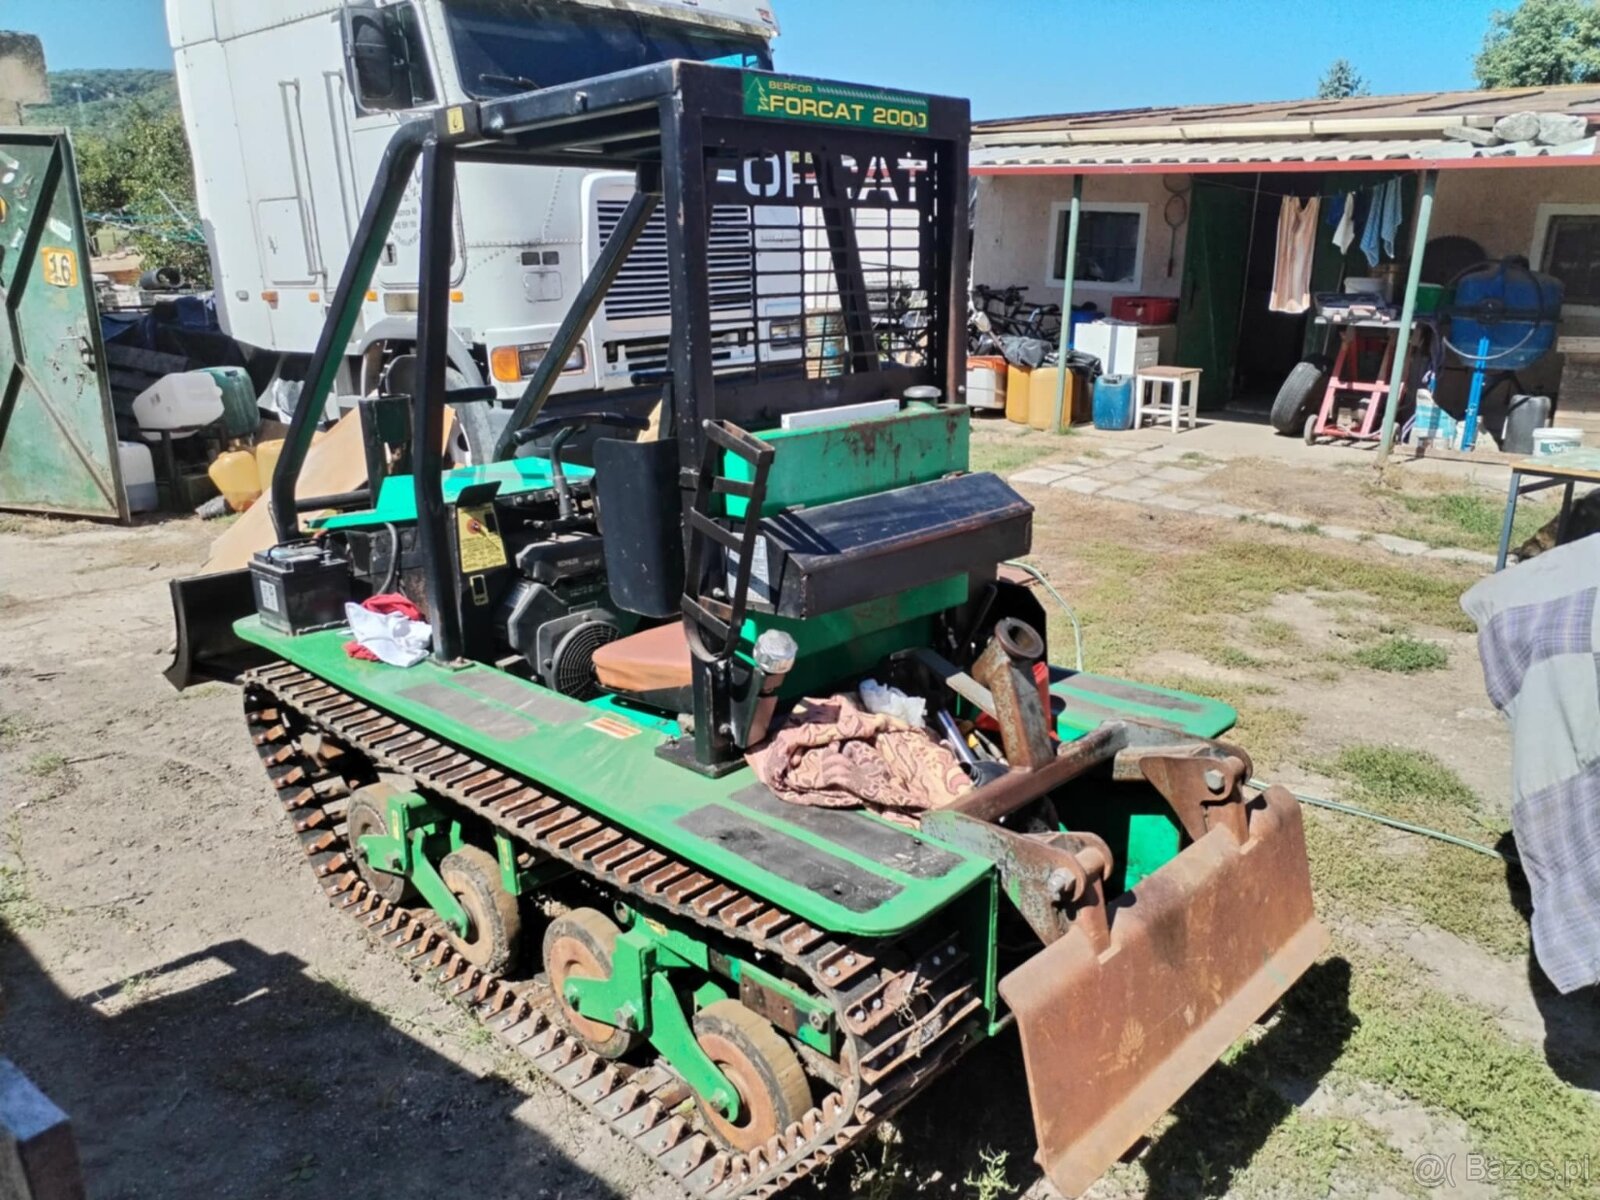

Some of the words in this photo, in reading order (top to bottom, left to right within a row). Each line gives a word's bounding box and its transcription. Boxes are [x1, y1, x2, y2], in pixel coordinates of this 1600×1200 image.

[768, 80, 813, 93] BERFOR
[769, 95, 865, 121] FORCAT
[873, 107, 927, 128] 2000
